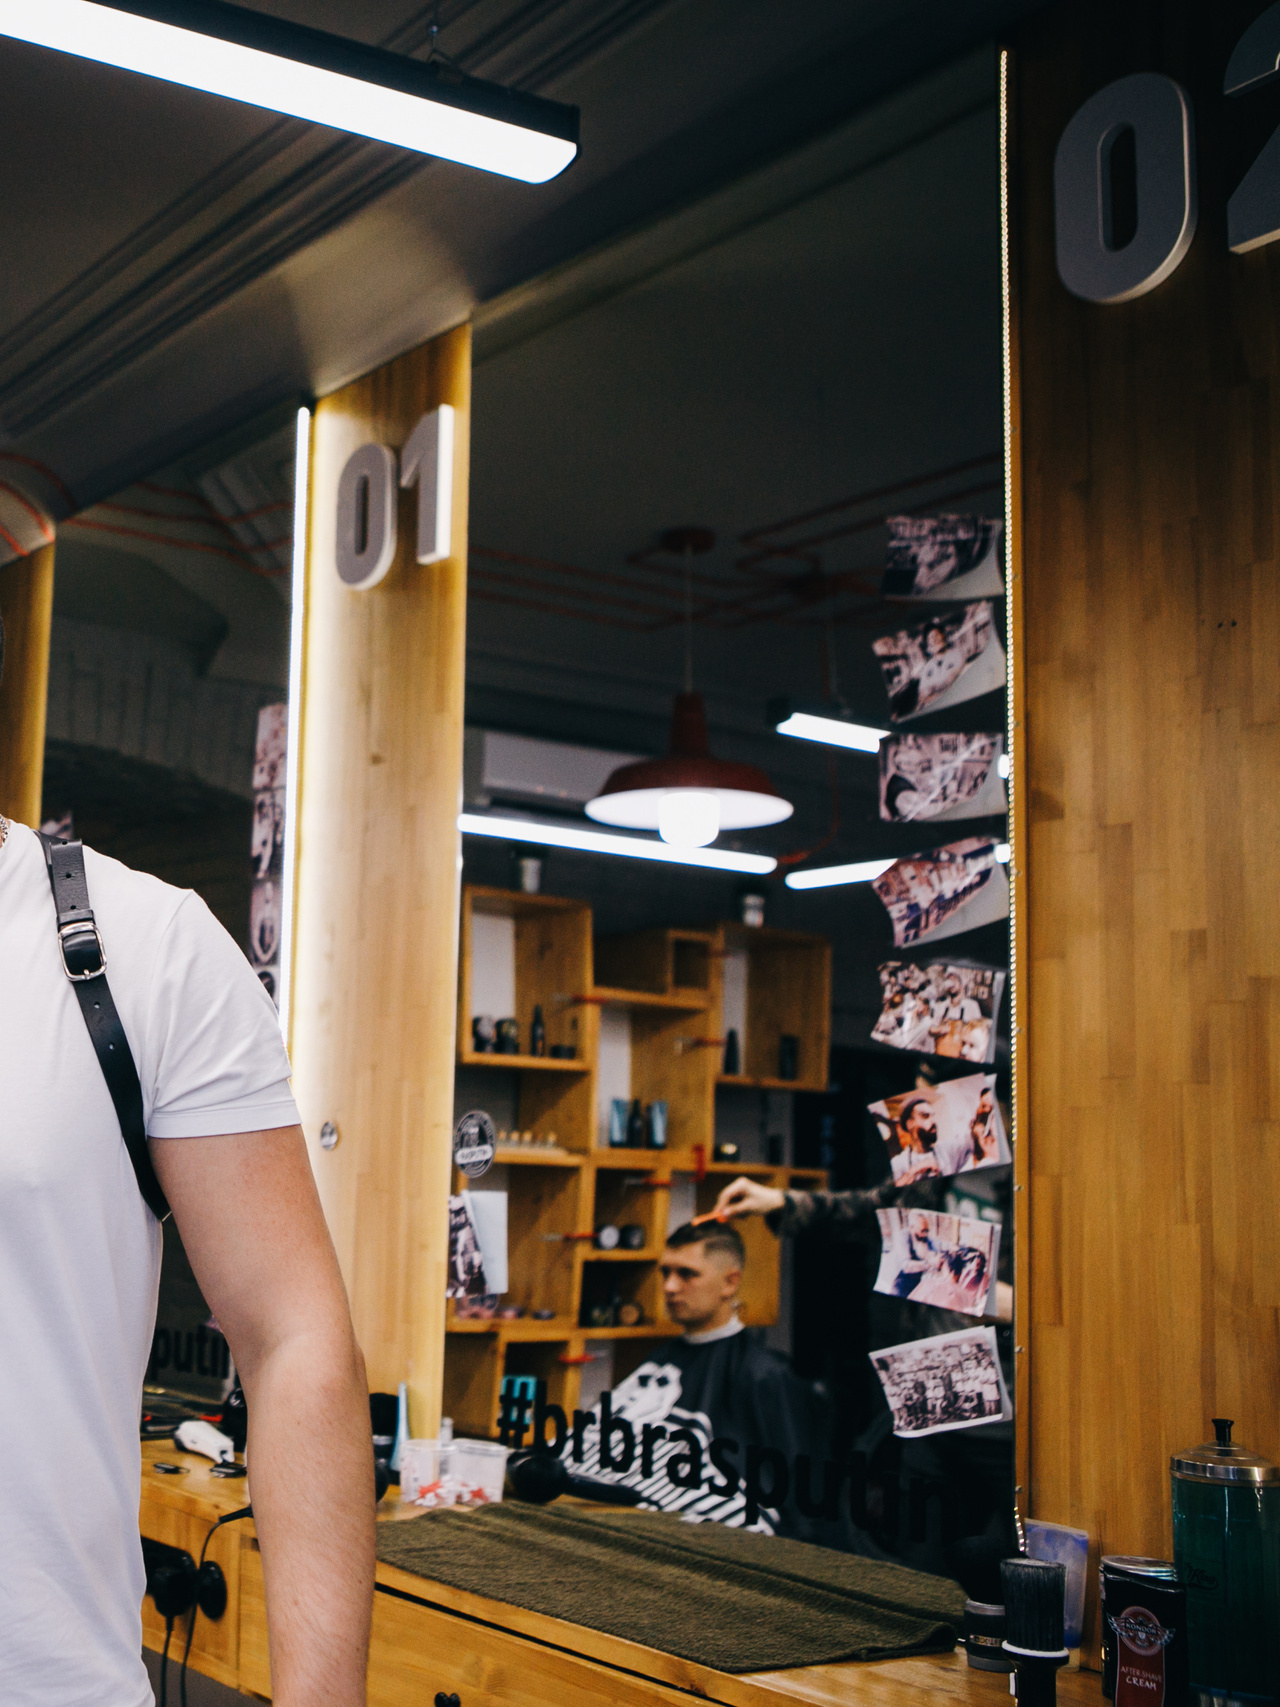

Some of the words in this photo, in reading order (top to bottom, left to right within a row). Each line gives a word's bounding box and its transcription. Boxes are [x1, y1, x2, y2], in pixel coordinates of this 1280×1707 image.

[335, 403, 455, 591] 01
[497, 1374, 956, 1547] #brbrasputin
[1125, 1622, 1157, 1635] KONDOR
[1125, 1675, 1157, 1691] CREAM
